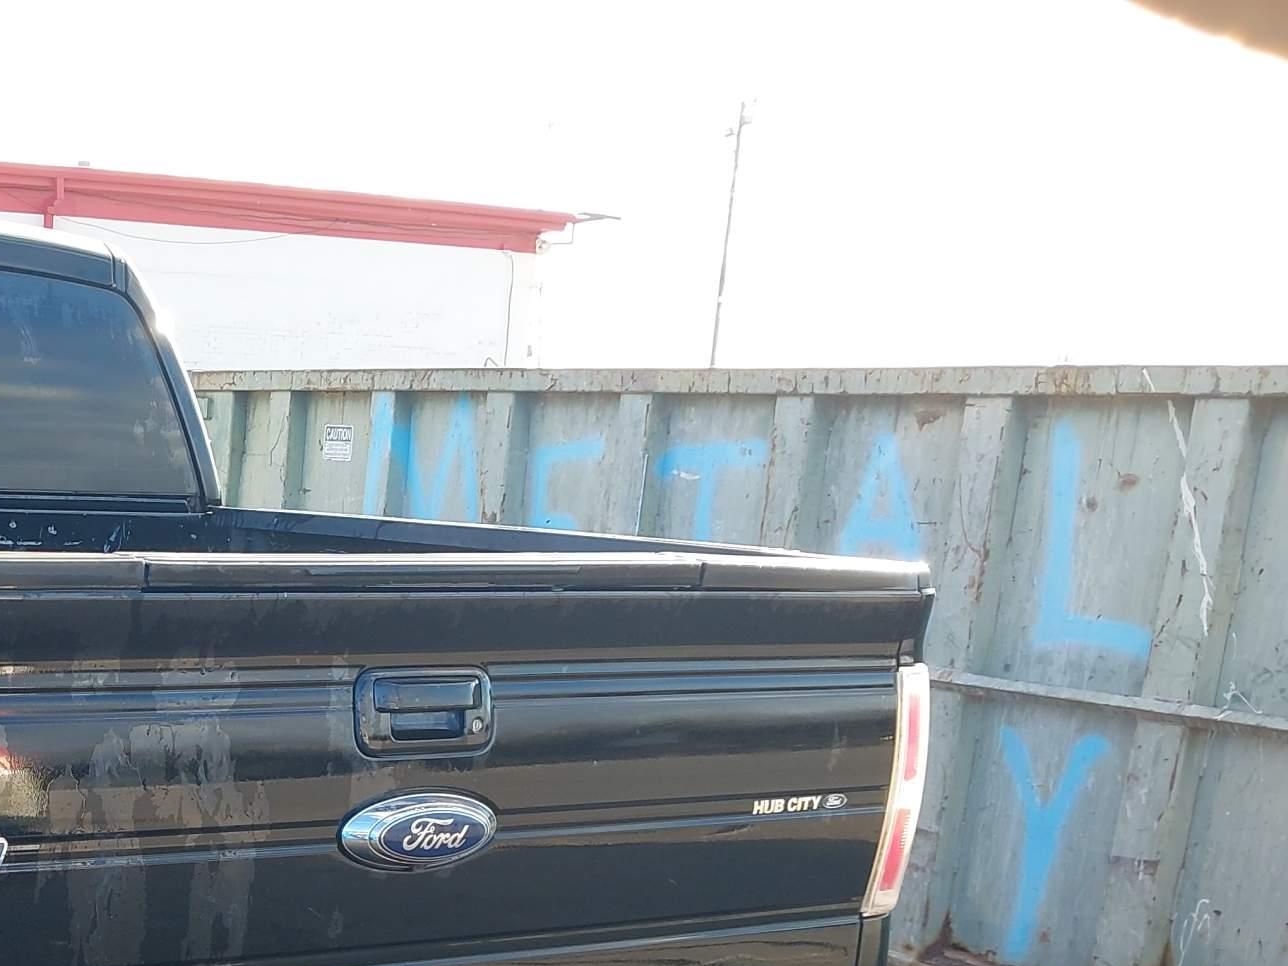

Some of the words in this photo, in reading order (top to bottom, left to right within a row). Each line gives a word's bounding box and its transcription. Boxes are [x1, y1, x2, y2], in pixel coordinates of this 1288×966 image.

[326, 427, 352, 441] CAUTION
[365, 393, 1152, 660] METAL
[752, 798, 785, 815] HUB
[787, 795, 822, 812] CITY
[403, 817, 469, 851] Ford
